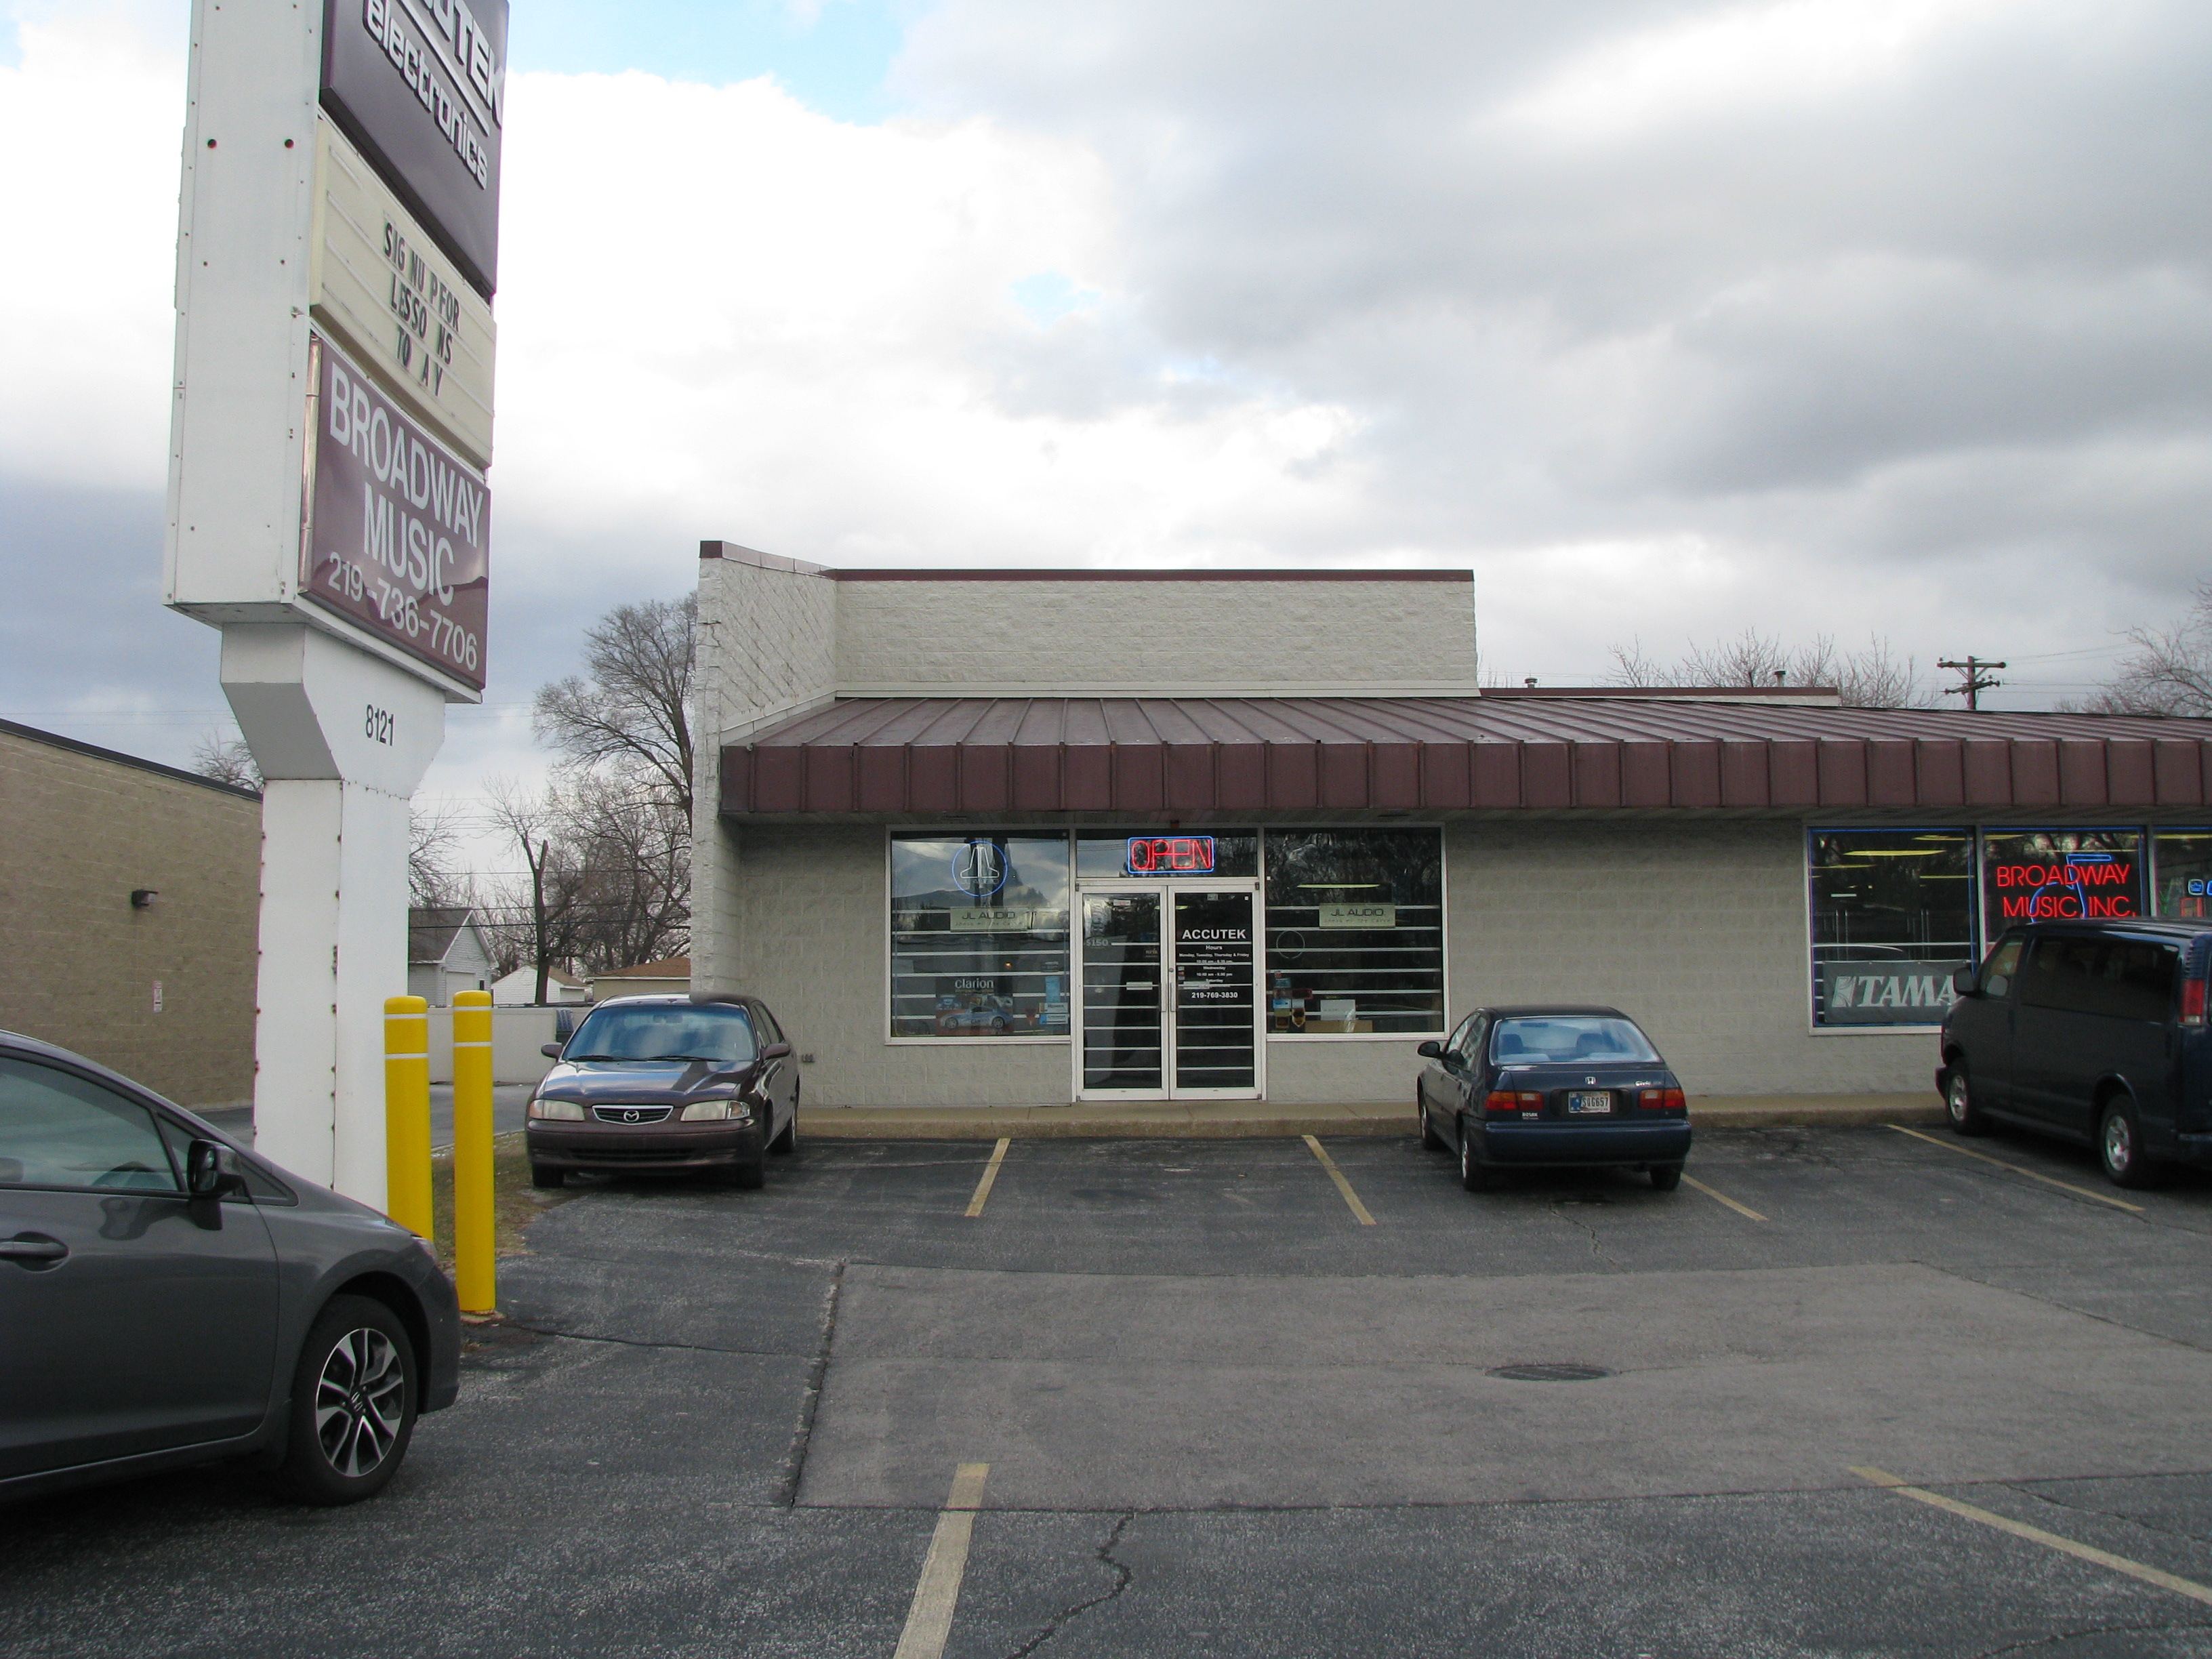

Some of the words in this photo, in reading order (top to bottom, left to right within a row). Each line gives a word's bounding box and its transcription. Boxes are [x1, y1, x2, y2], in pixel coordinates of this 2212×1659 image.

[329, 361, 483, 548] BROADWAY
[363, 481, 454, 607] MUSIC
[328, 551, 477, 672] 219-736-7706
[365, 704, 394, 747] 8121
[1130, 838, 1213, 871] OPEN
[1995, 863, 2132, 888] BROADWAY
[962, 912, 976, 920] JL
[978, 911, 1015, 919] AUDIO
[2088, 896, 2137, 918] INC.
[1182, 929, 1247, 940] ACCUTEK
[1856, 975, 1958, 1007] TAMA
